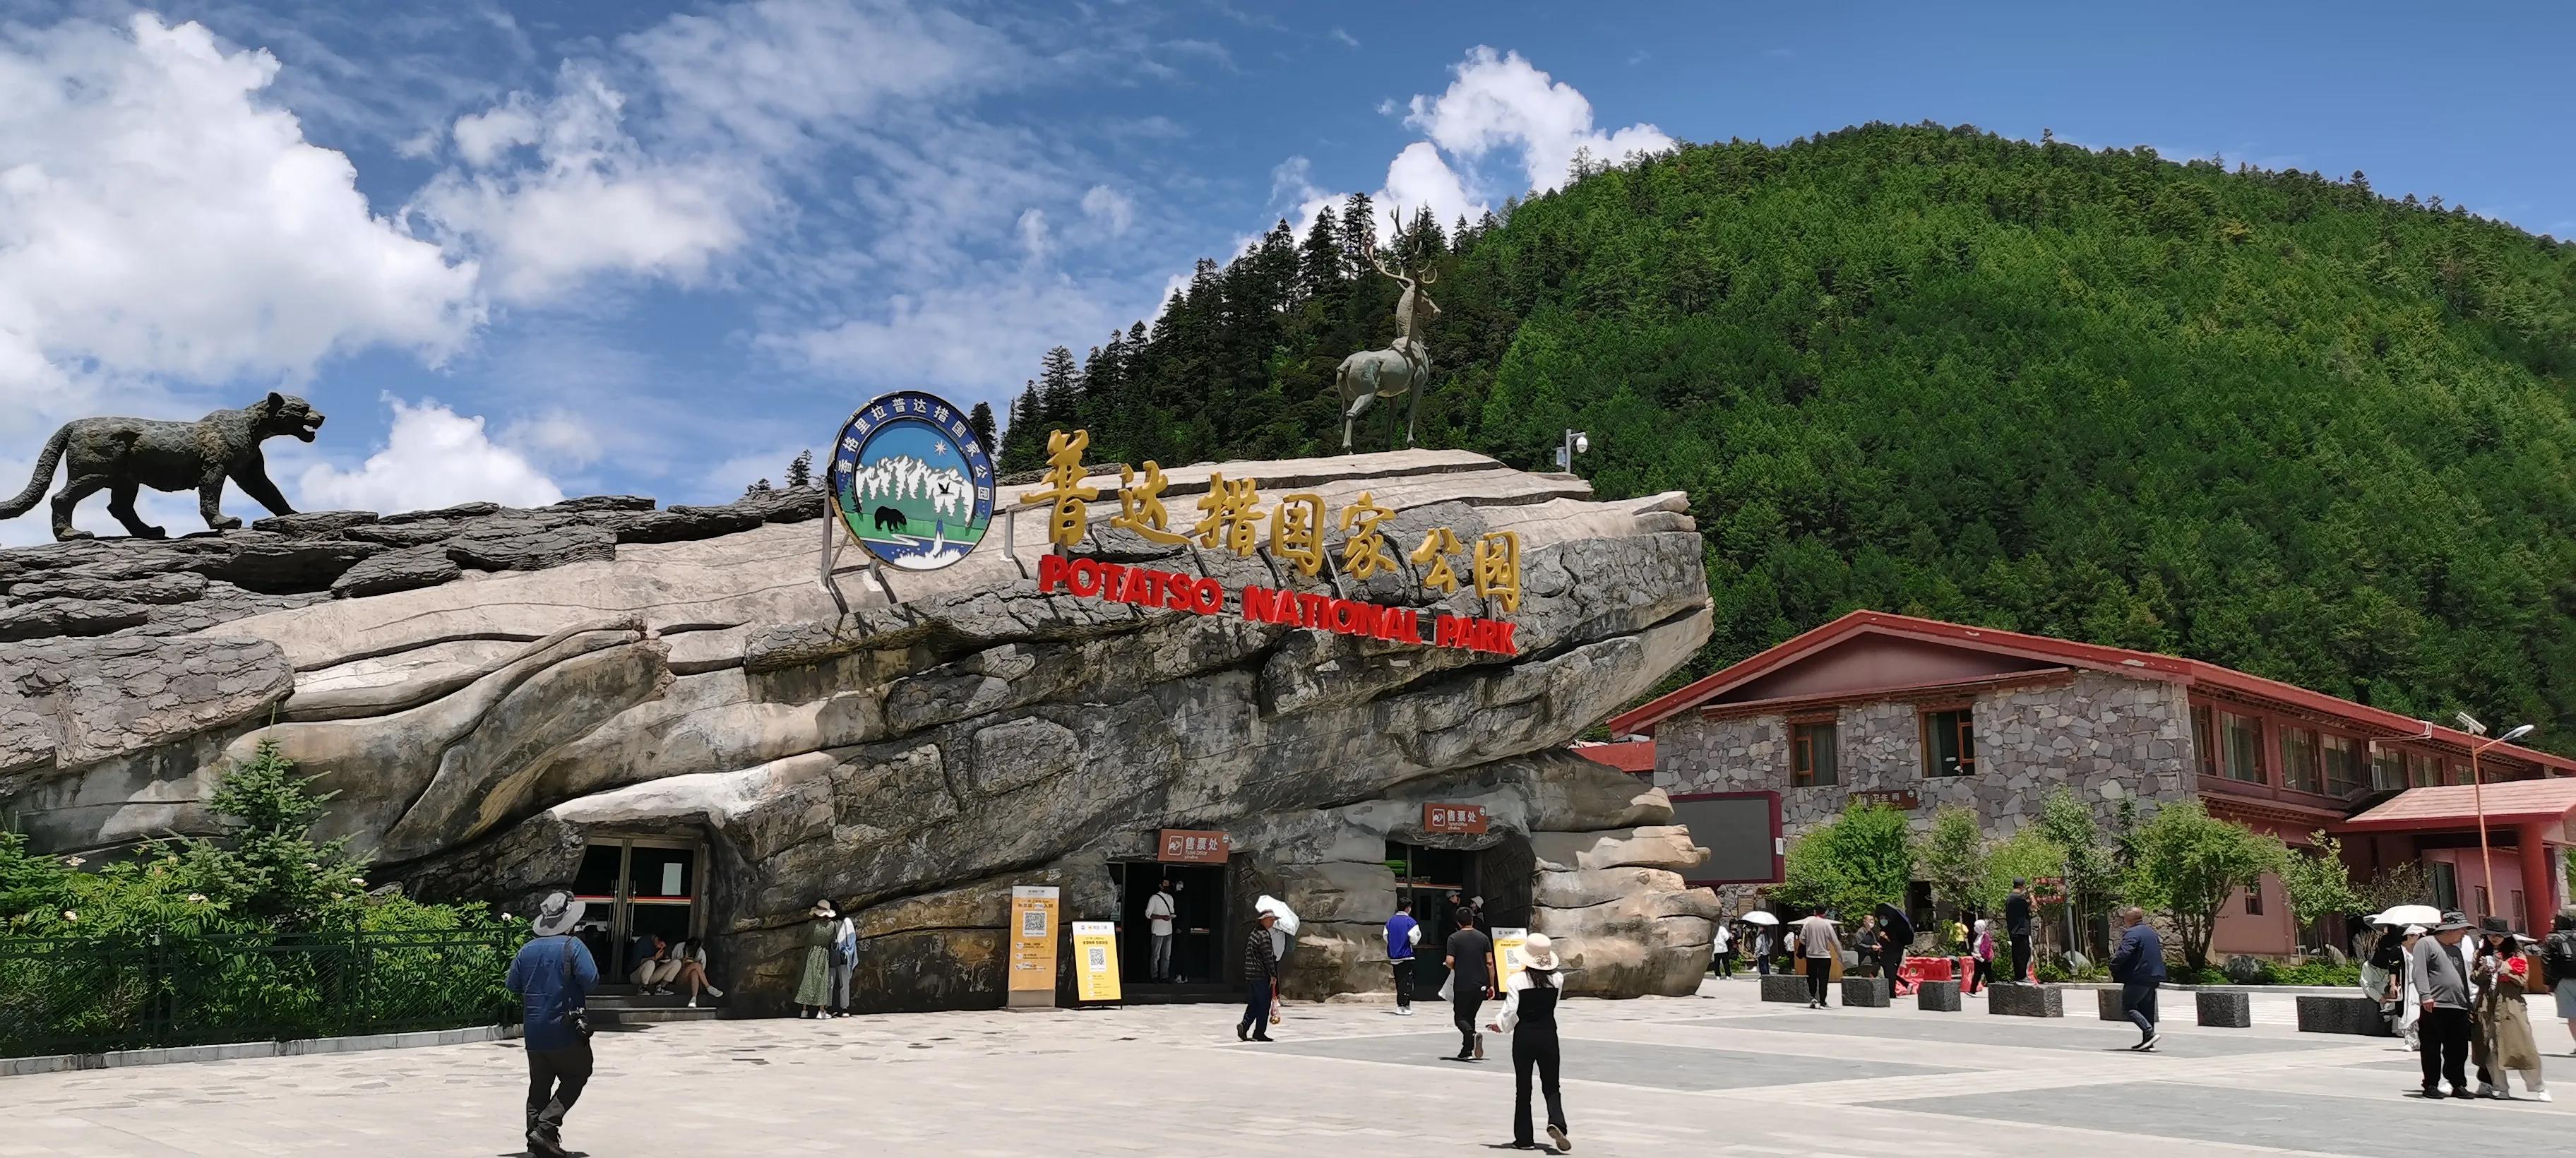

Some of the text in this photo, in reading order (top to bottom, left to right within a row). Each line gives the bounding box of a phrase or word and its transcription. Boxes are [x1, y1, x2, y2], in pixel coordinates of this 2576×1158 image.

[837, 397, 990, 501] 香格里拉普达措国家公园
[1021, 429, 1520, 613] 普达措国家公园
[1039, 554, 1517, 655] POTATSO NATIONAL PARK
[1186, 836, 1218, 851] 售票处
[1447, 809, 1477, 823] 售票处
